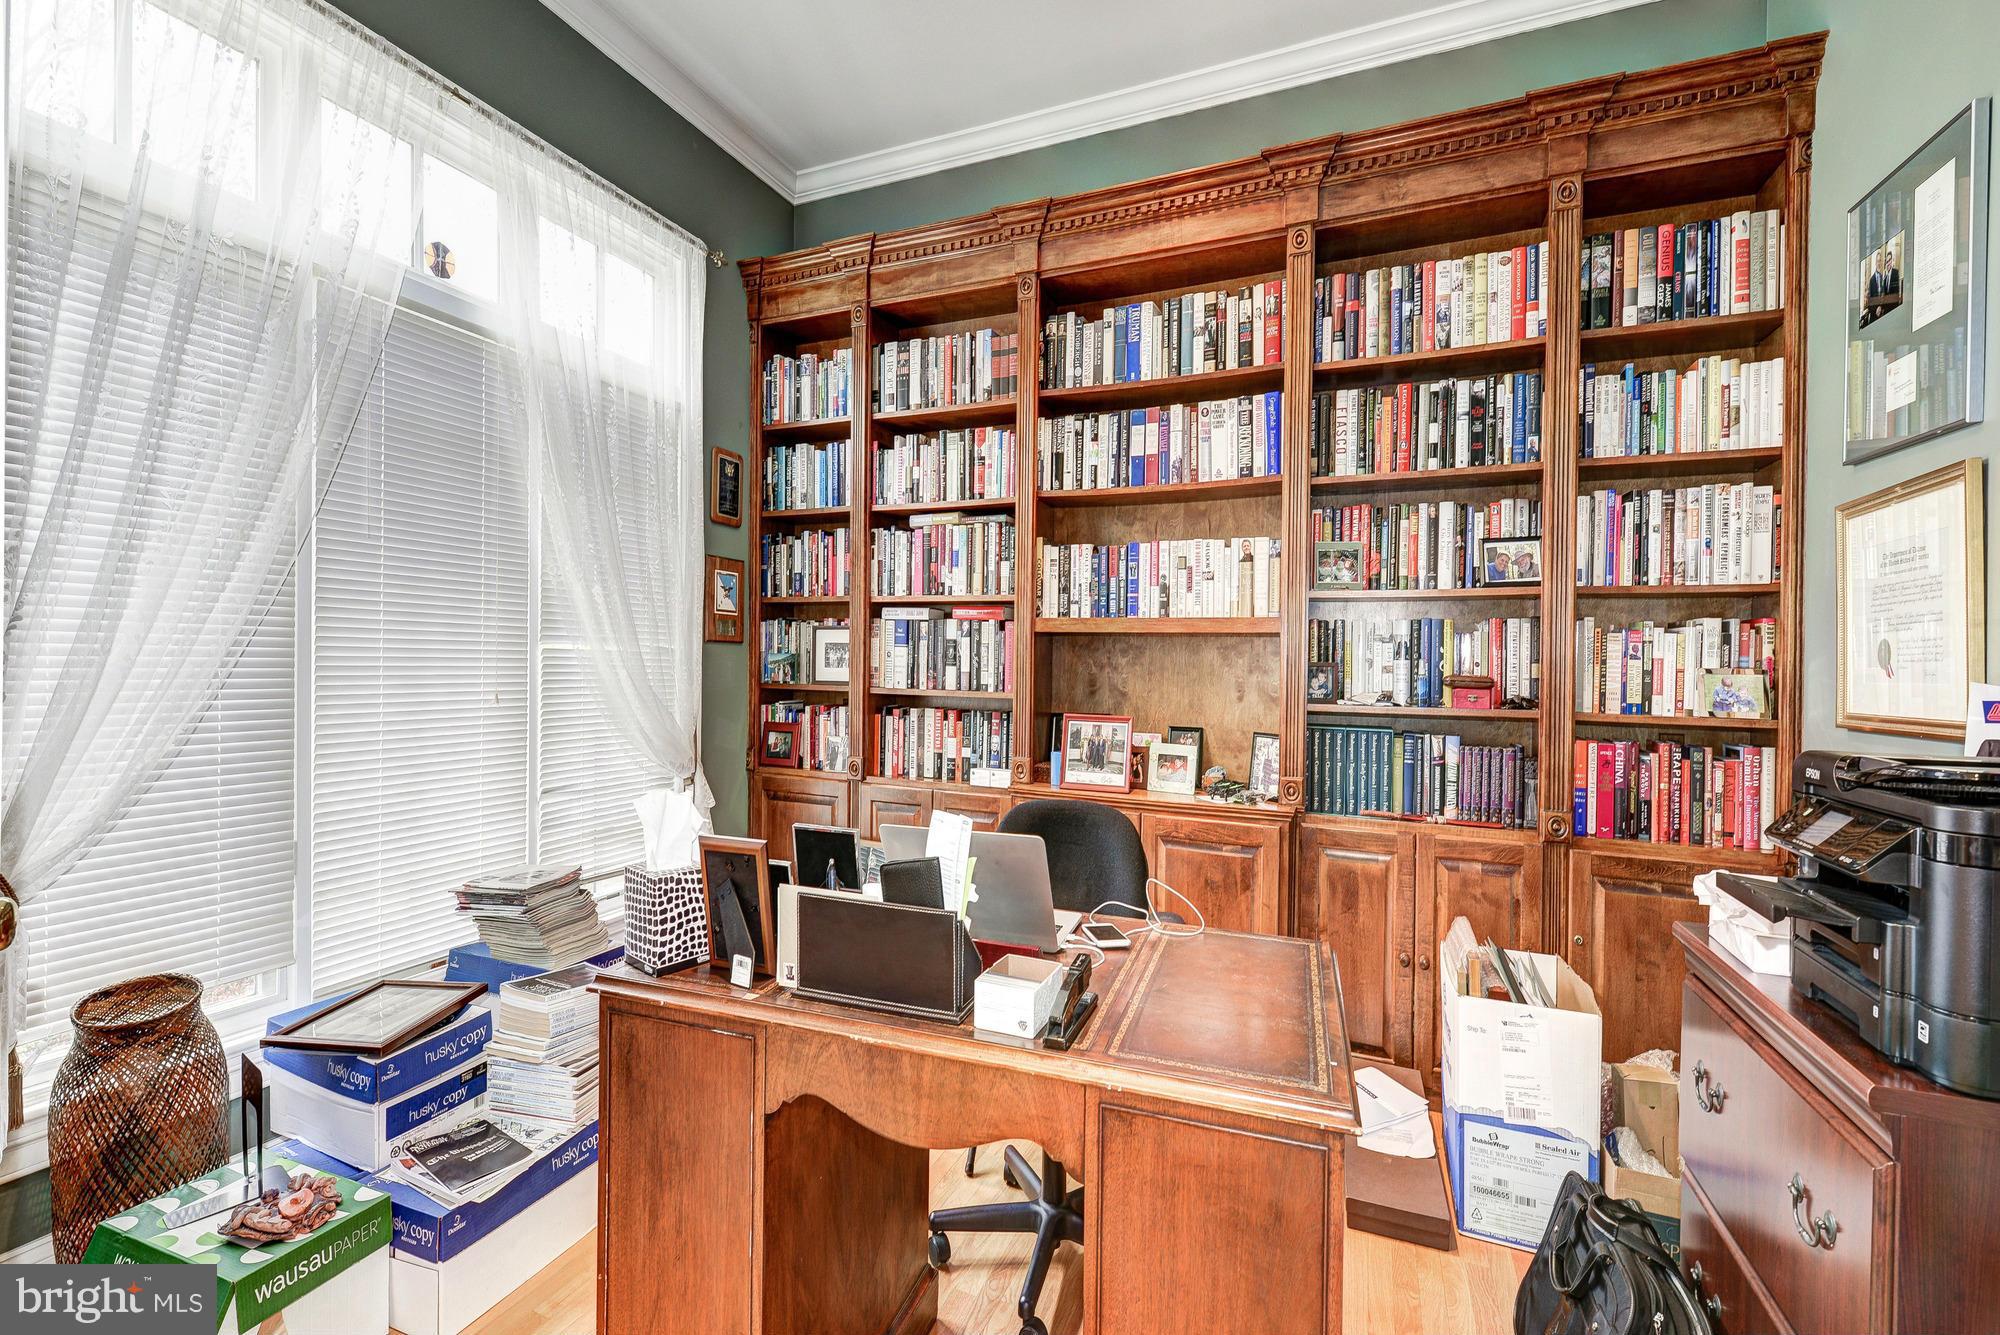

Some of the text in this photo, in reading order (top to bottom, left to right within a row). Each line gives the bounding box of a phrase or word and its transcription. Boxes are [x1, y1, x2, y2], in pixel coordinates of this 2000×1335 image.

[1661, 230, 1671, 272] GENIUS
[1130, 306, 1140, 342] TRUMAN
[1240, 411, 1250, 424] THE
[1586, 379, 1594, 424] Wonderful Life
[1240, 424, 1252, 467] RECKONING
[1336, 408, 1347, 454] FIASCO
[1721, 503, 1730, 540] CONSUMERS'
[1616, 751, 1625, 784] CHINA
[1806, 768, 1820, 780] EPSON
[1673, 753, 1681, 830] RAPE NANKING
[1744, 754, 1753, 841] Pamuk of Innocence
[425, 1024, 487, 1065] husky copy
[327, 1059, 372, 1092] husky copy
[408, 1086, 468, 1122] husky copy
[552, 1133, 598, 1172] husky cop
[1542, 1144, 1580, 1157] Sealed Air
[392, 1215, 434, 1247] sky copy
